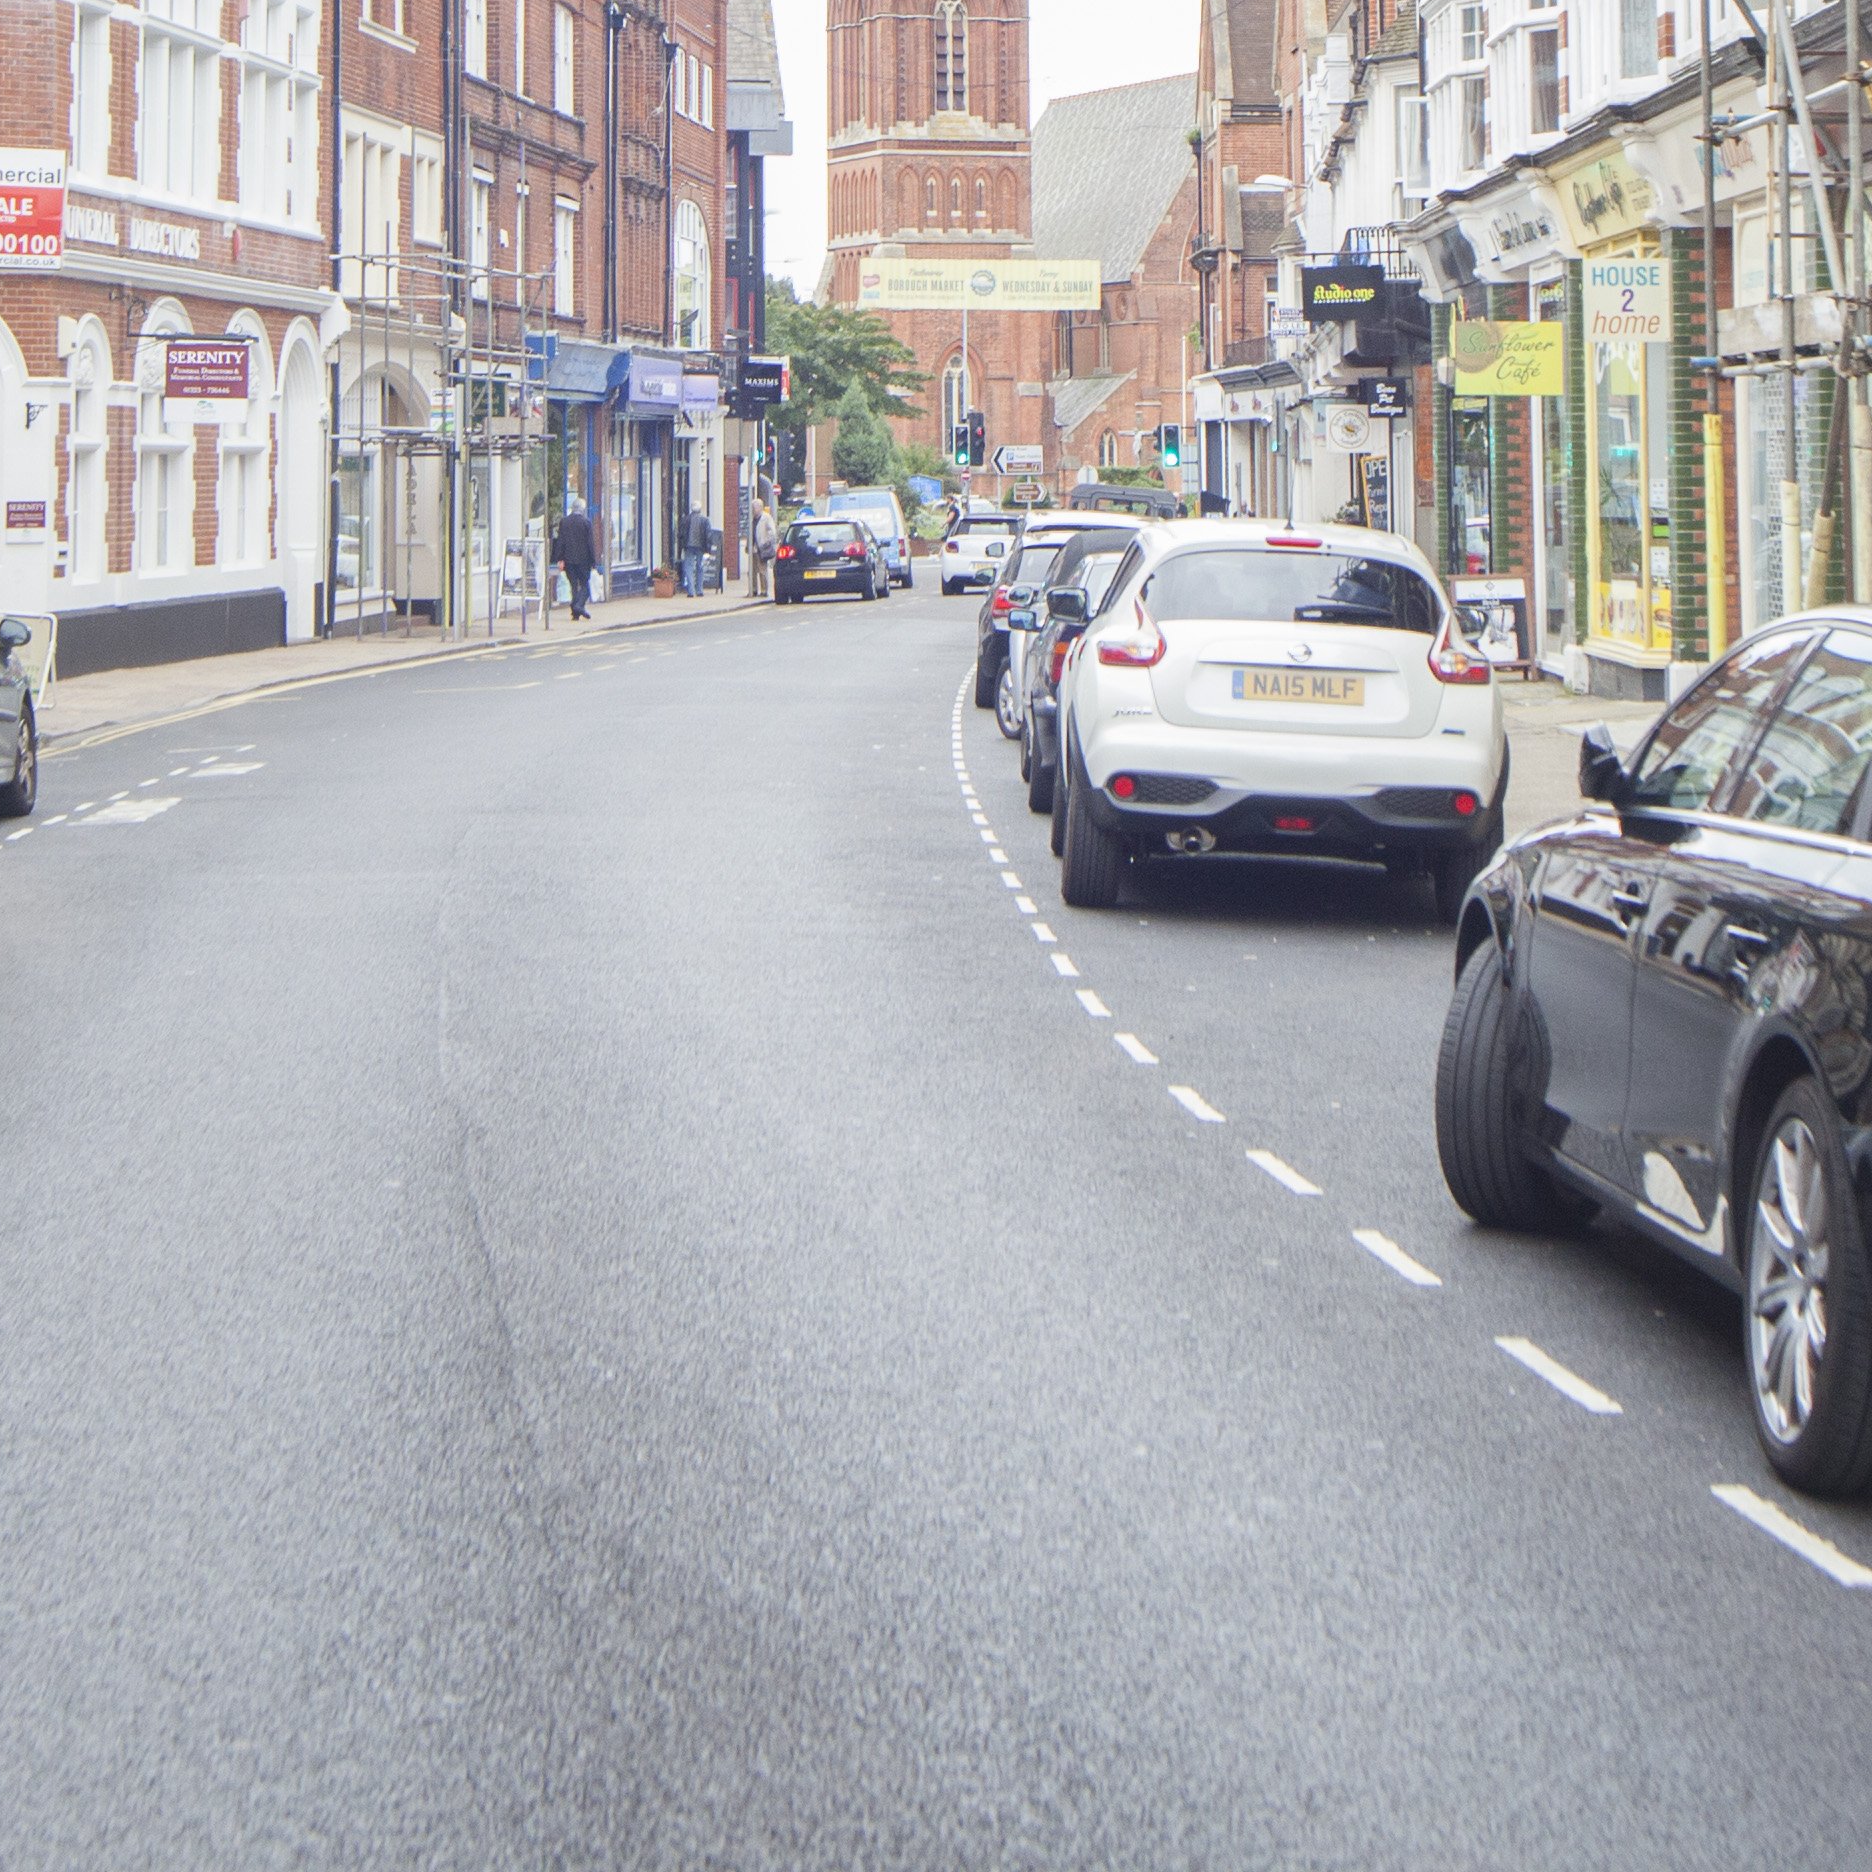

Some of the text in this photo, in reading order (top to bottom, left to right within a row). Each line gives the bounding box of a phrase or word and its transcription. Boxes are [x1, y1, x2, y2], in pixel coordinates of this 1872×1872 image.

[64, 205, 201, 260] UNERAL DIRECTORS
[888, 279, 928, 291] BOROUGH
[931, 280, 965, 291] MARKET
[1002, 280, 1051, 293] WEDNESDAY
[1053, 282, 1061, 293] &
[1062, 281, 1093, 293] SUNDAY
[1592, 267, 1660, 286] HOUSE
[1313, 283, 1375, 301] studio one
[1621, 288, 1634, 312] 2
[1592, 310, 1661, 334] home
[1463, 330, 1554, 359] Sunflower
[169, 351, 245, 364] SERENITY
[1496, 355, 1542, 385] Café
[744, 378, 779, 386] MAXIMS
[1365, 460, 1387, 478] OPE
[1253, 673, 1358, 699] NA15 MLF
